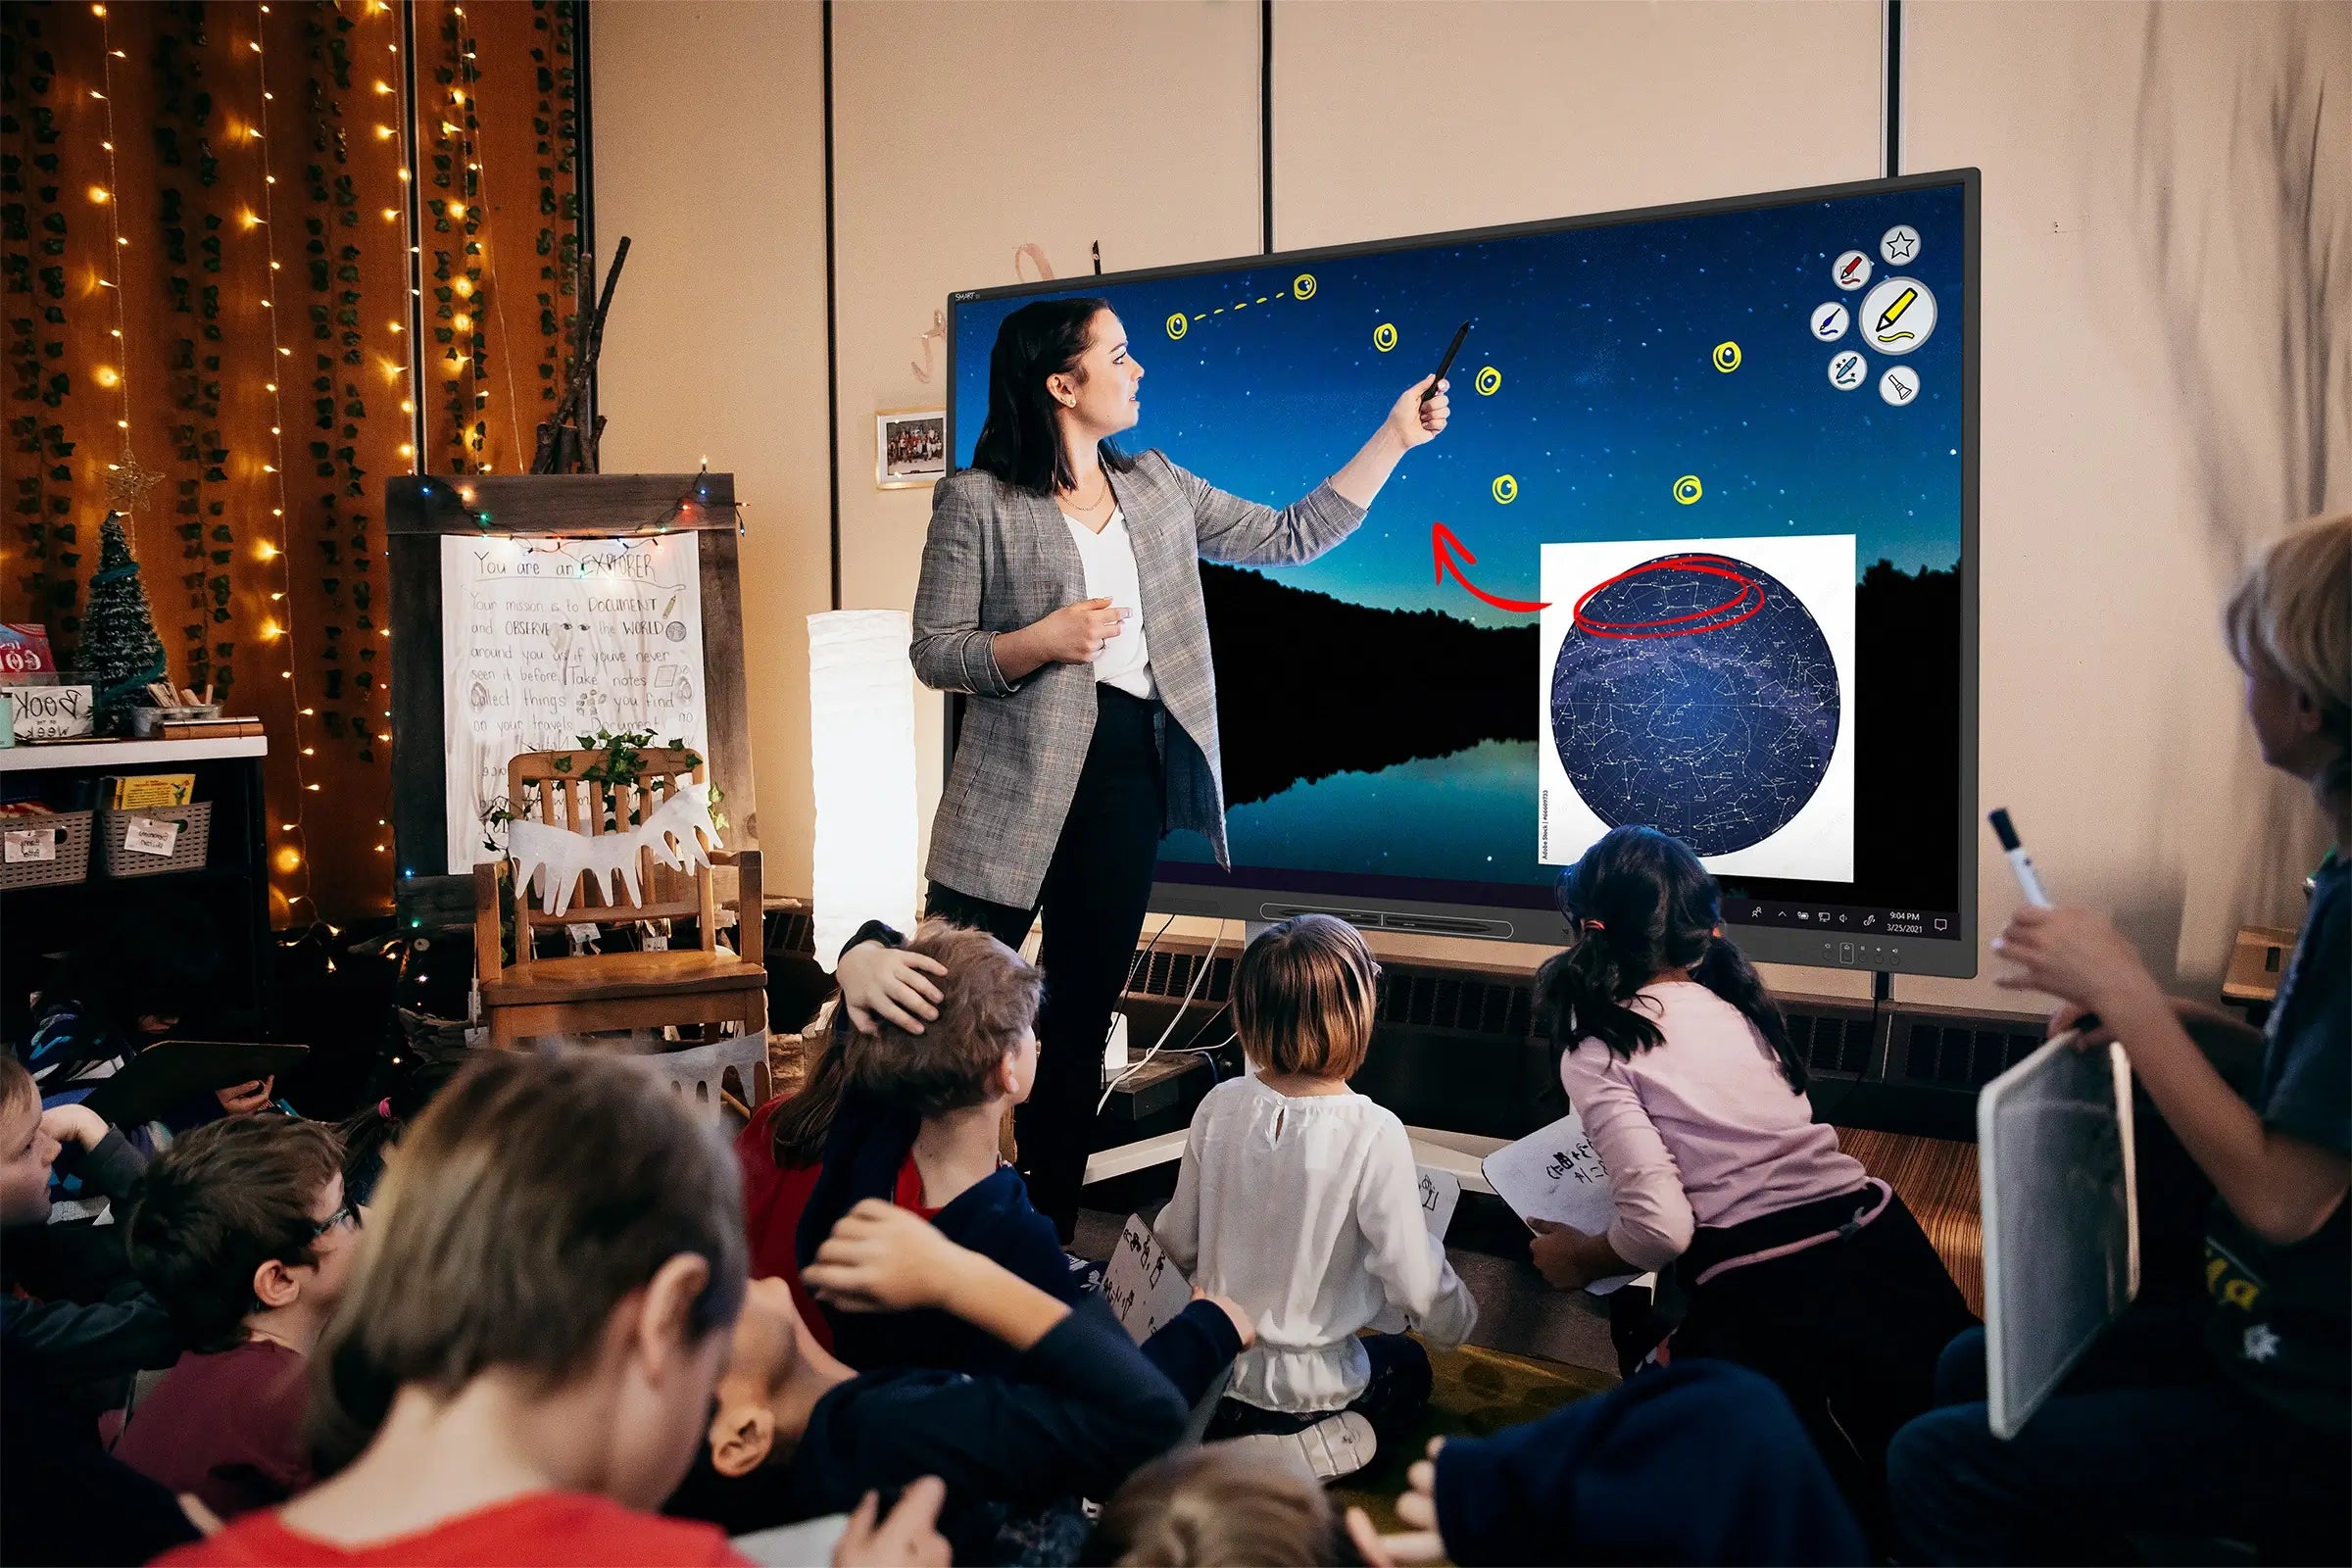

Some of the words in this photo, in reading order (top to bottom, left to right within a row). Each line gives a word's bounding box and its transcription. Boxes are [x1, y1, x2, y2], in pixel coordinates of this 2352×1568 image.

[955, 291, 976, 302] SMART
[474, 551, 507, 574] You
[516, 562, 541, 575] are
[556, 564, 574, 576] an
[469, 592, 498, 611] Your
[506, 600, 544, 612] mission
[551, 601, 561, 612] is
[566, 598, 579, 612] to
[588, 596, 659, 612] DOCUMENT
[470, 619, 494, 634] and
[505, 620, 551, 637] OBSERVE
[599, 619, 616, 636] the
[622, 620, 664, 635] WORLD
[470, 646, 513, 660] around
[522, 650, 544, 666] you
[553, 651, 567, 662] as
[573, 647, 584, 662] if
[635, 651, 670, 663] never
[470, 668, 496, 681] seen
[503, 666, 512, 682] it
[568, 665, 599, 686] Take
[612, 668, 648, 687] notes
[470, 686, 511, 707] Collect
[523, 687, 566, 714] things
[613, 696, 638, 713] you
[646, 691, 674, 708] find
[473, 719, 488, 732] on
[497, 719, 524, 737] your
[1889, 910, 1905, 920] 9:04
[1906, 912, 1920, 921] PM
[1886, 922, 1923, 934] 3/25/2021
